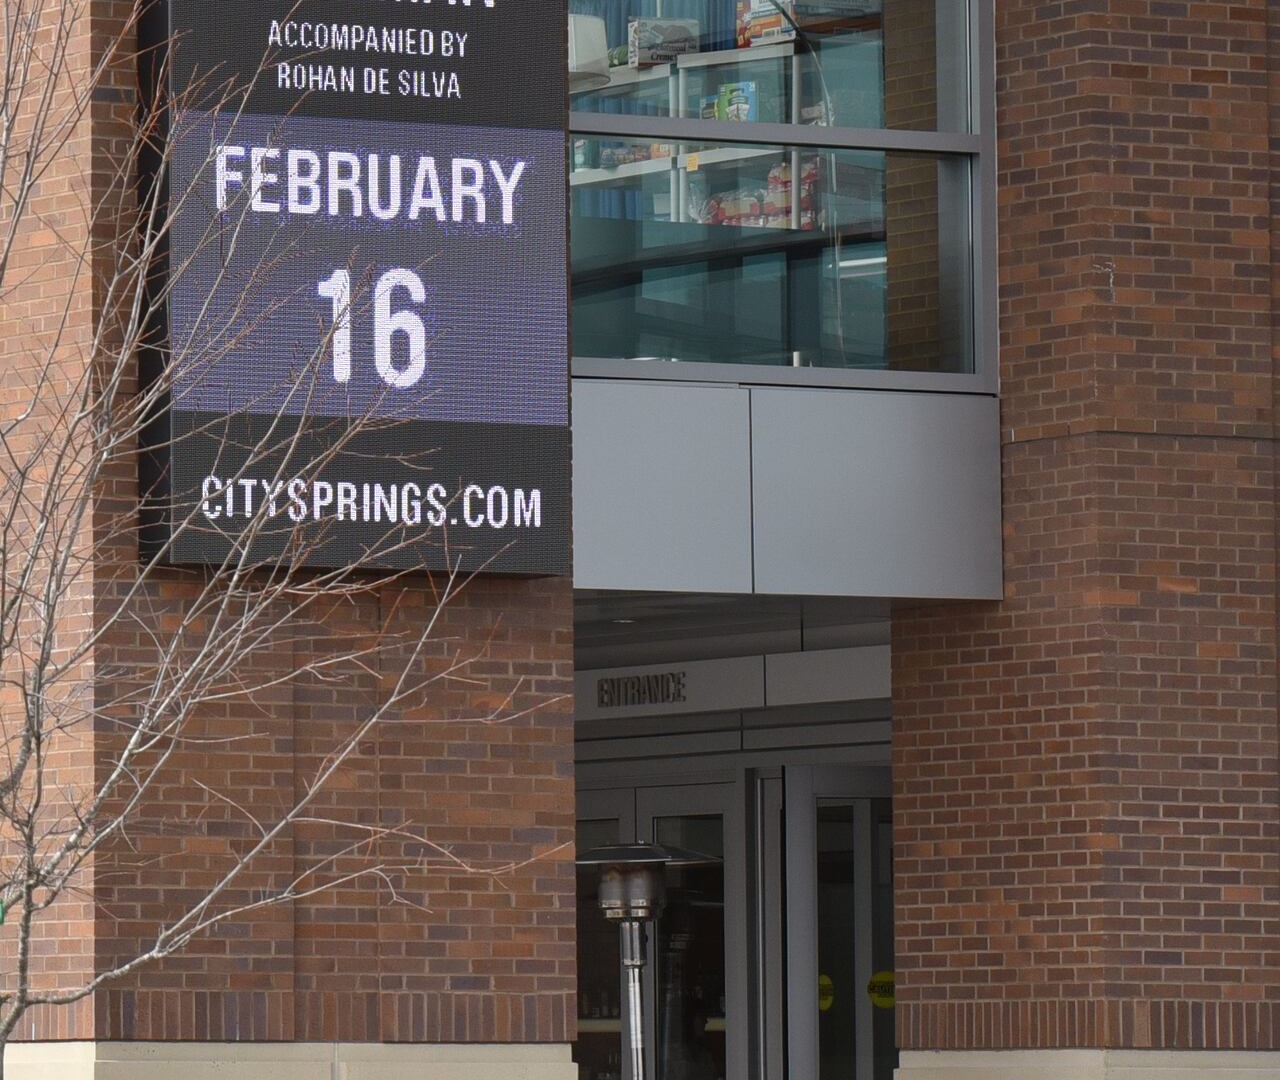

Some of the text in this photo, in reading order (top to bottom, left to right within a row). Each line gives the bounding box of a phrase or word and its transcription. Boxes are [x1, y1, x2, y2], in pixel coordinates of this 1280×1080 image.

[268, 20, 468, 58] ACCOMPANIED BY
[277, 62, 461, 99] ROHAN DE SILVA
[215, 145, 525, 224] FEBRUARY
[318, 268, 426, 388] 16
[202, 475, 541, 528] CITYSPRINGS.COM
[597, 672, 686, 708] ENTRANCE
